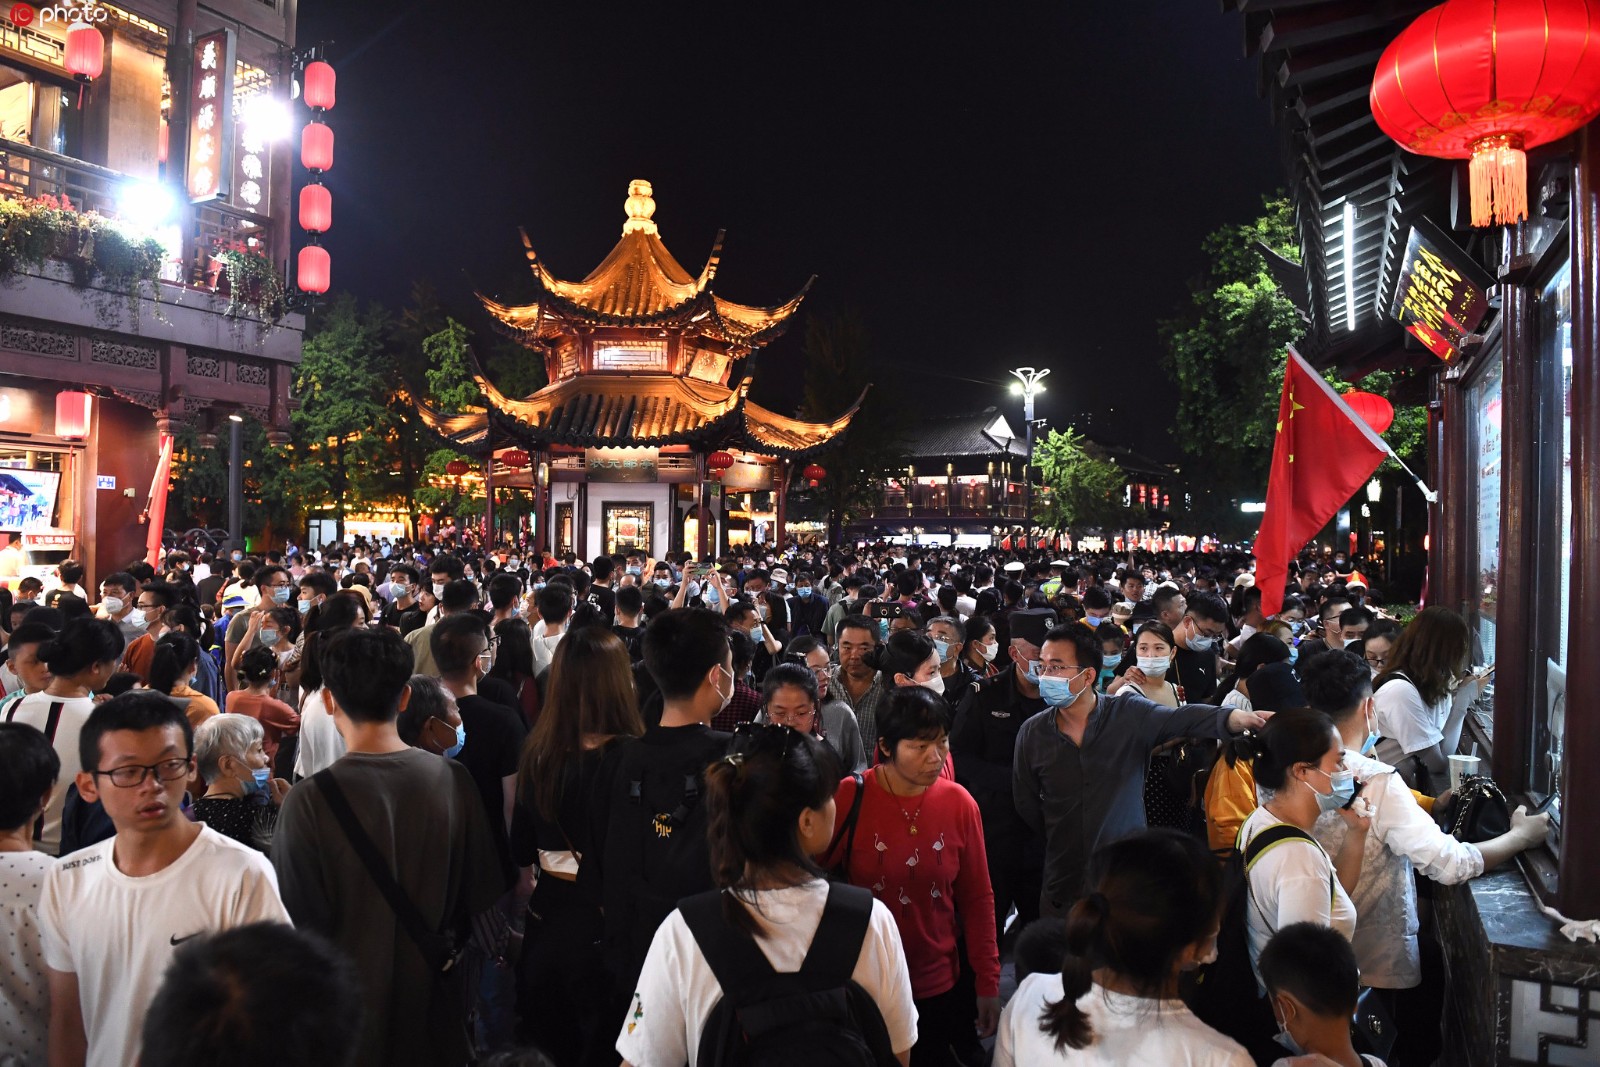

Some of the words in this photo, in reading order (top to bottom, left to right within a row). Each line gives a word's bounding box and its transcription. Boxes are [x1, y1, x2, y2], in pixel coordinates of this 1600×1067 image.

[589, 458, 654, 470] 状元邮亭
[62, 860, 81, 871] JUST
